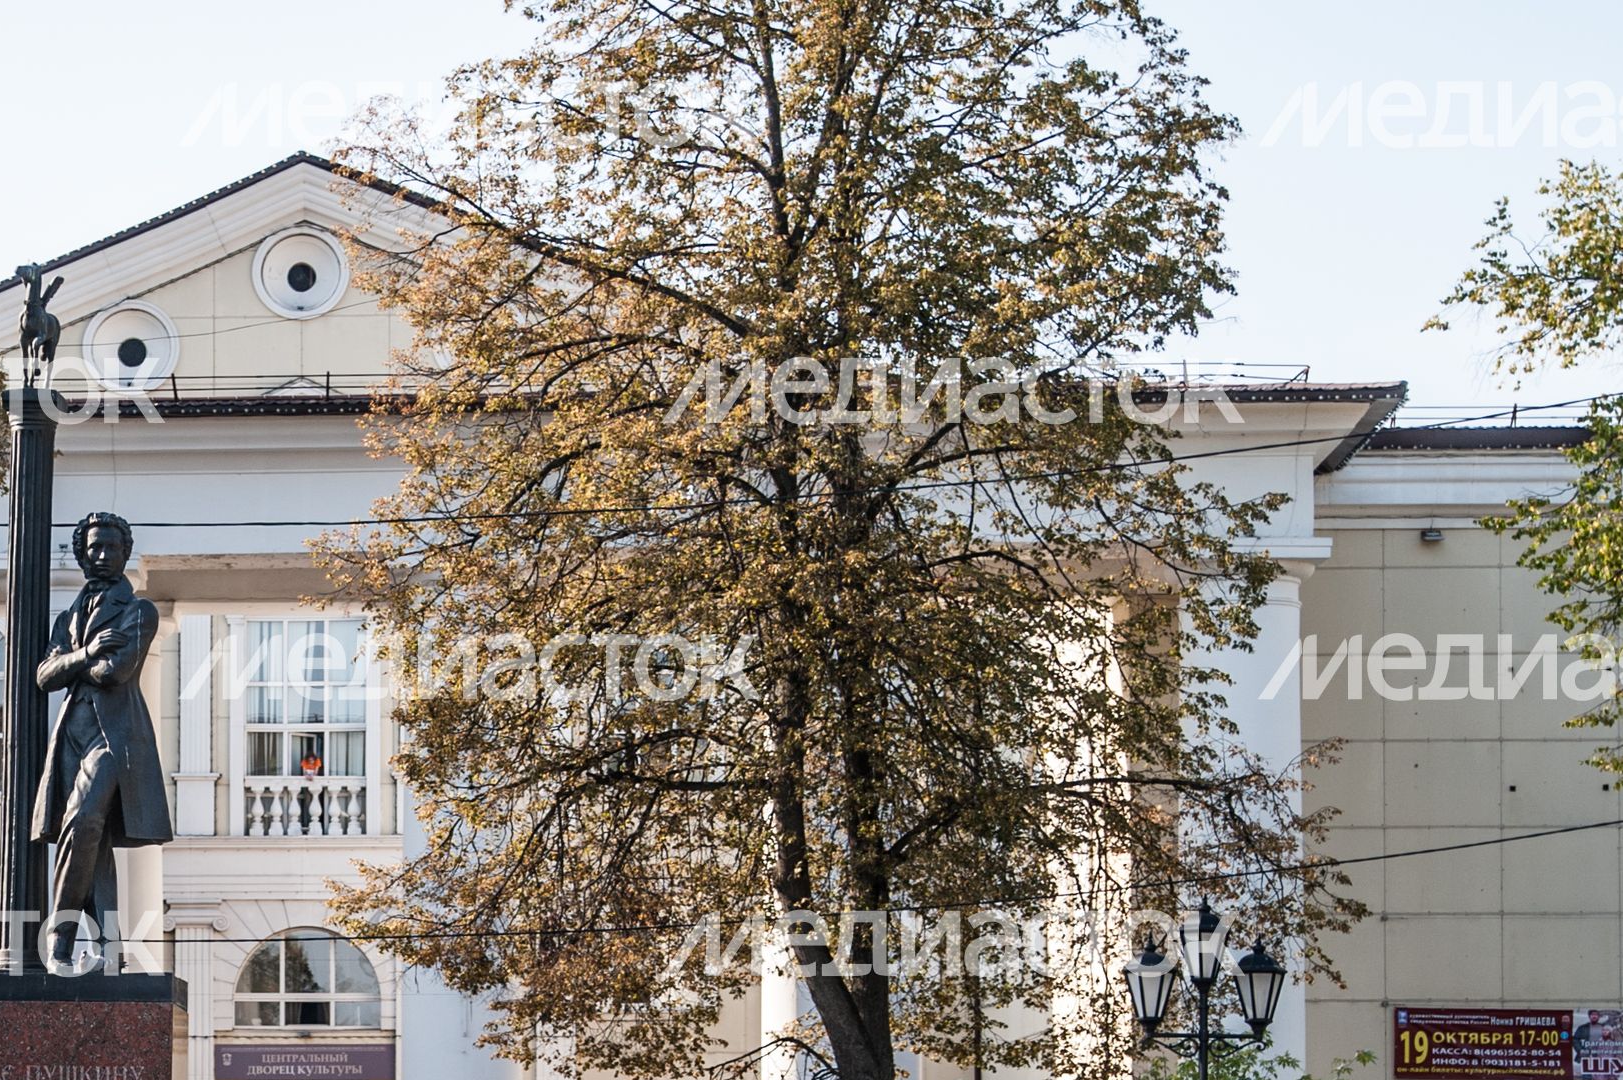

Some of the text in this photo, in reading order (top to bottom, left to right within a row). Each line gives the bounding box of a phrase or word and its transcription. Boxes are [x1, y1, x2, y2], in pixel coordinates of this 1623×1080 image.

[1490, 1016, 1557, 1027] Нонна ГРИШАЕВА
[1432, 1031, 1559, 1046] ОКТЯБРЯ 17-00
[1400, 1031, 1429, 1065] 19
[1432, 1047, 1472, 1056] КАССА:
[261, 1052, 349, 1064] ЦЕНТРАЛЬНЫЙ
[1432, 1058, 1471, 1066] ИНФО:
[247, 1065, 362, 1076] ДВОРЕЦ КУЛЬТУРЫ
